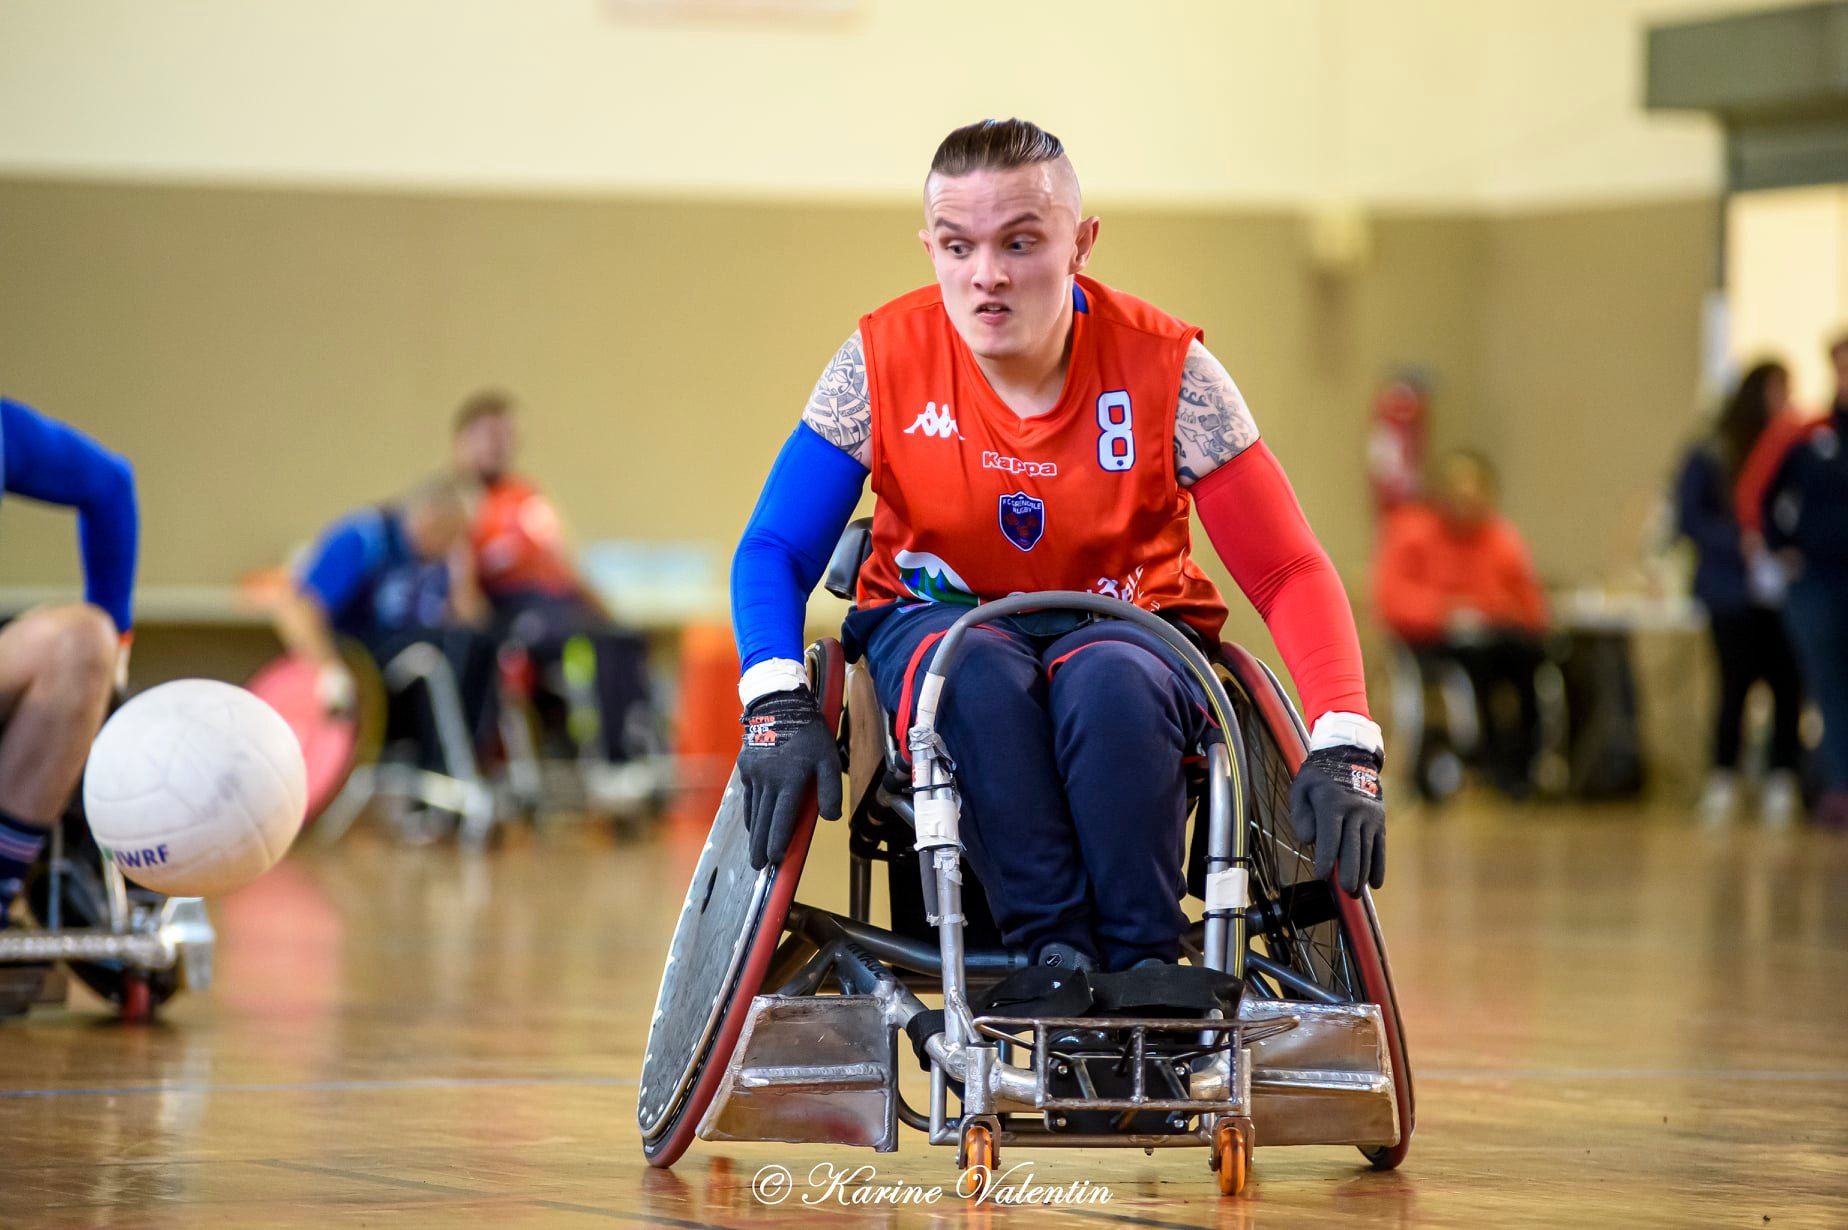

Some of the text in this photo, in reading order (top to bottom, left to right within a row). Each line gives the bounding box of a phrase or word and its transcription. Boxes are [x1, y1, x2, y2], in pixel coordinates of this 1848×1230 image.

[1096, 388, 1136, 472] 8
[982, 451, 1057, 477] Kappa
[114, 844, 170, 867] IWRF
